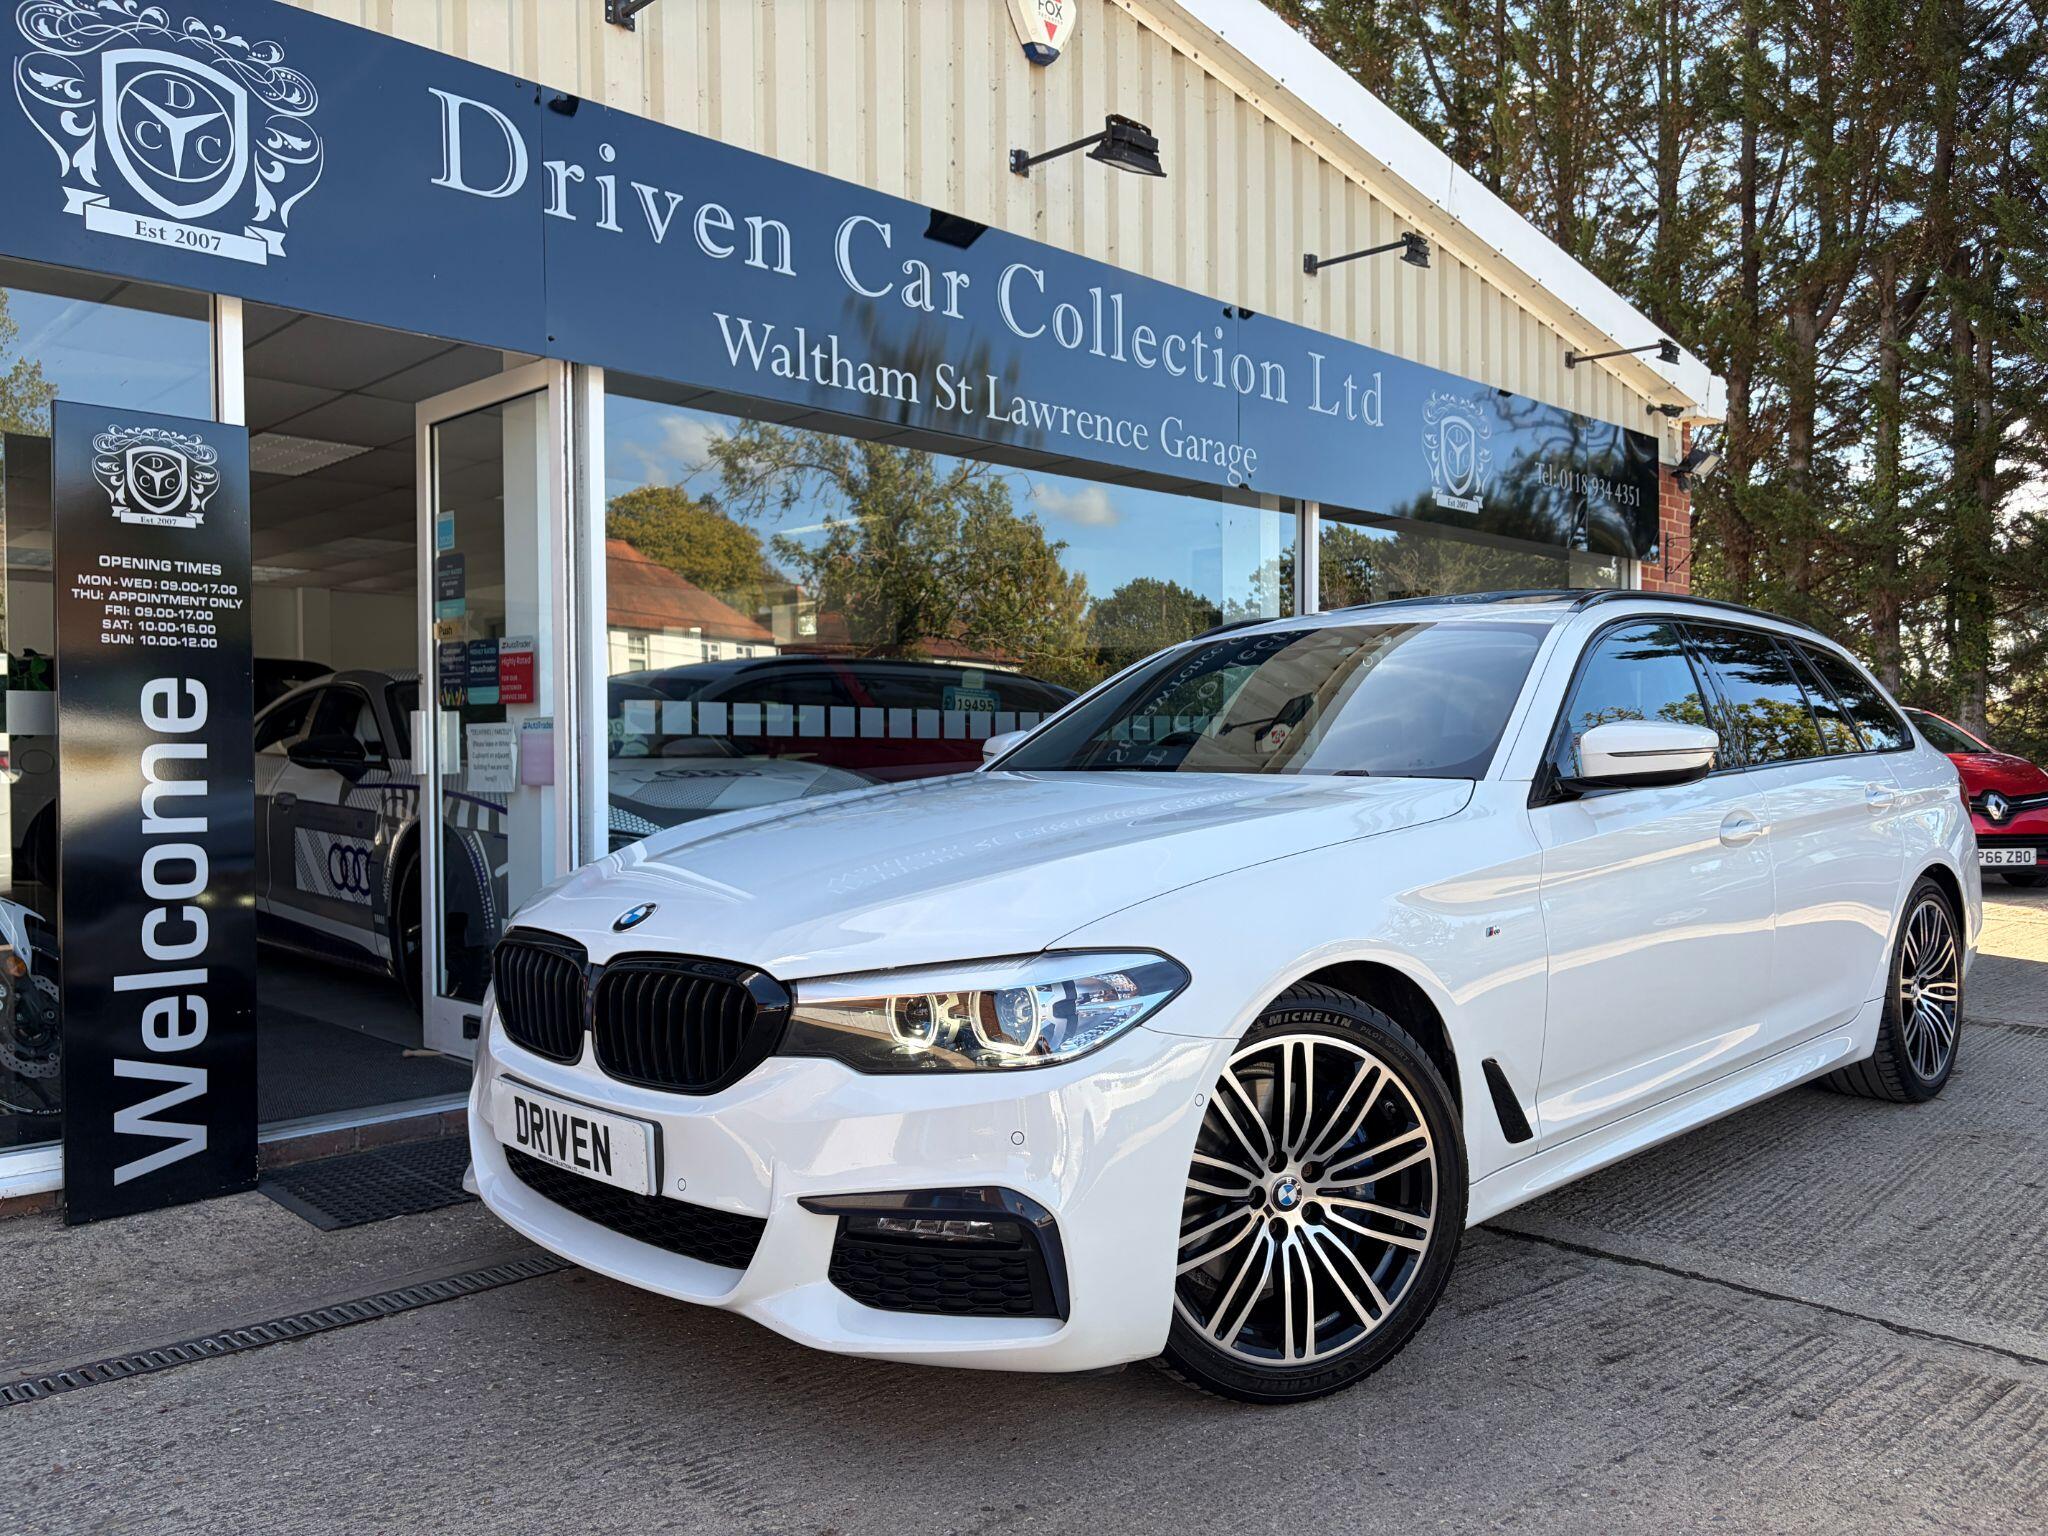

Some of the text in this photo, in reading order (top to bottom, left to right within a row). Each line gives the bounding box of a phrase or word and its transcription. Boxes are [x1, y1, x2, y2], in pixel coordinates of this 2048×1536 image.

[164, 79, 196, 110] D
[134, 120, 223, 164] C C
[134, 219, 222, 252] Est 2007
[428, 86, 1385, 427] Driven Car Collection Ltd
[713, 311, 1258, 487] Waltham St Lawrence Garage
[151, 457, 163, 470] D
[139, 475, 176, 489] C C
[1534, 461, 1640, 508] Tel: 0118 934 4351
[140, 516, 178, 527] Est 2007
[98, 554, 222, 576] OPENING TIMES
[77, 573, 112, 587] MON
[160, 580, 238, 596] 09.00-17.00
[71, 588, 243, 610] THU: APPOINTMENT ONLY
[105, 605, 214, 621] FRI: 09.00-17.00
[102, 619, 216, 635] SAT: 10.00-16.00
[439, 625, 453, 636] Push
[101, 633, 217, 648] SUN: 10.00-12.00
[113, 676, 209, 1187] Welcome
[1268, 1011, 1352, 1029] MICHELIN
[514, 1095, 613, 1177] DRIVEN
